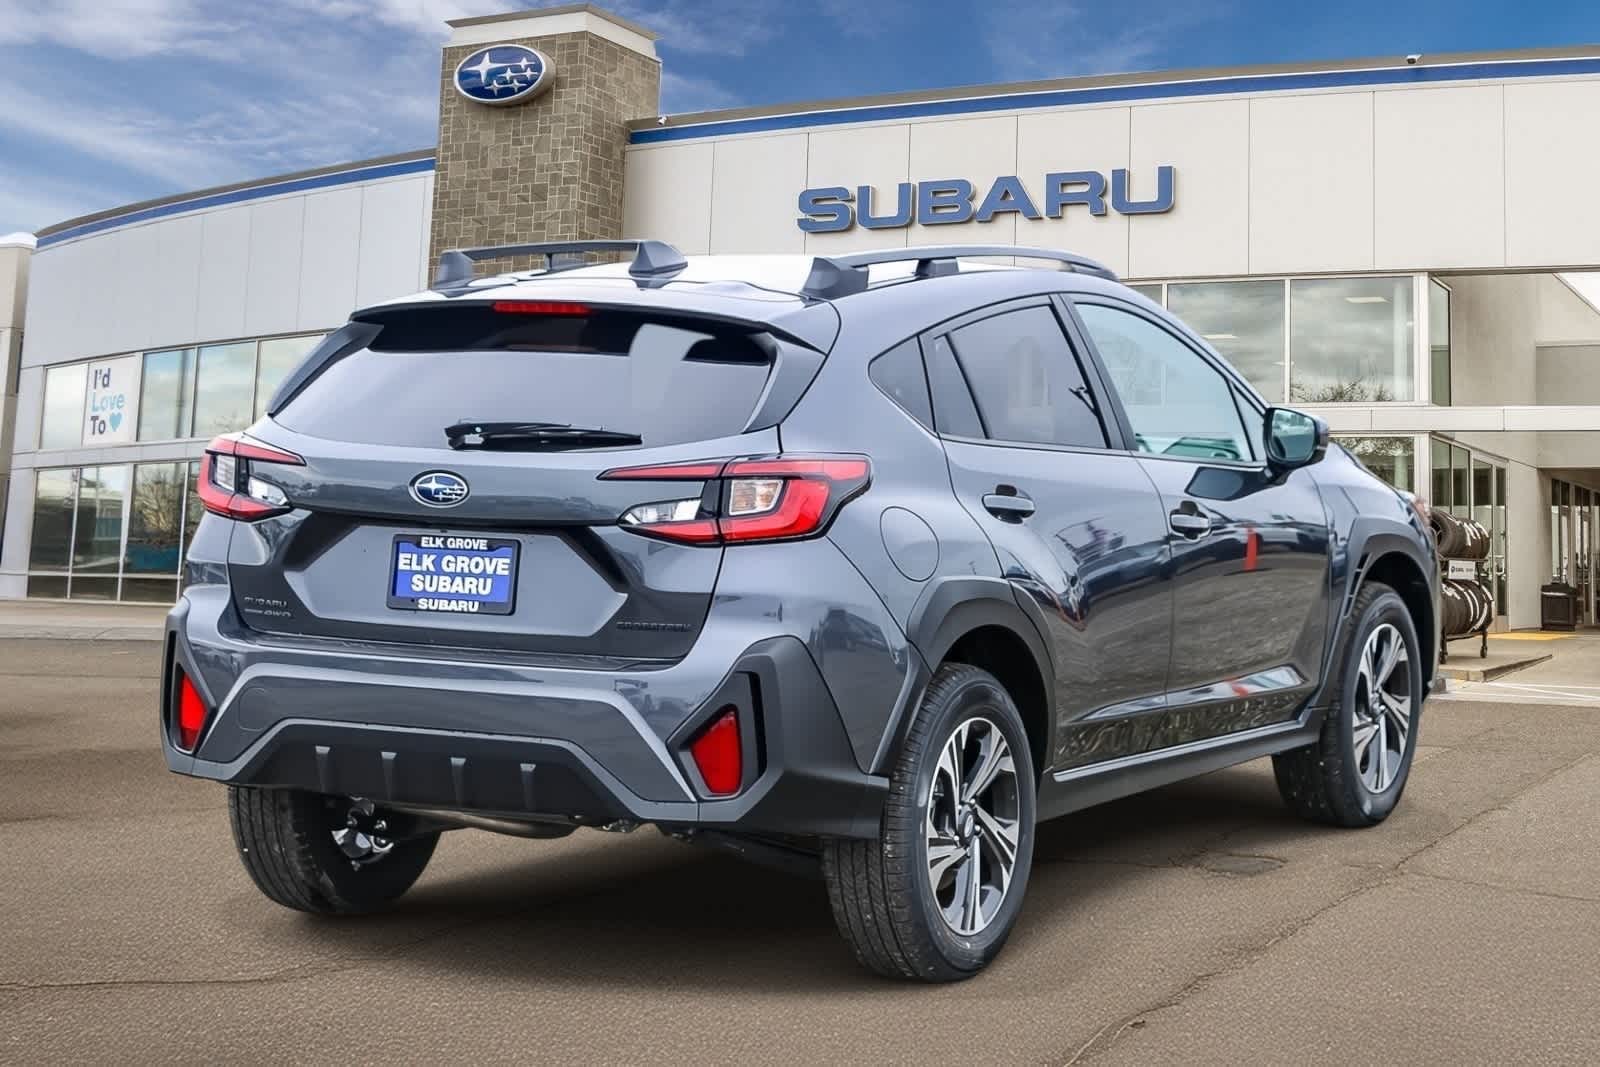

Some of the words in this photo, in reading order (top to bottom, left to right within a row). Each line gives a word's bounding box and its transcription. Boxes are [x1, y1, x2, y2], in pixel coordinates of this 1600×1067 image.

[796, 165, 1177, 233] SUBARU
[93, 367, 111, 390] I'd
[91, 392, 125, 412] Love
[90, 415, 106, 436] To
[420, 536, 444, 549] ELK
[446, 537, 488, 551] GROVE
[398, 552, 437, 572] ELK
[441, 555, 511, 576] GROVE
[411, 574, 493, 596] SUBARU
[417, 597, 480, 612] SUBARU
